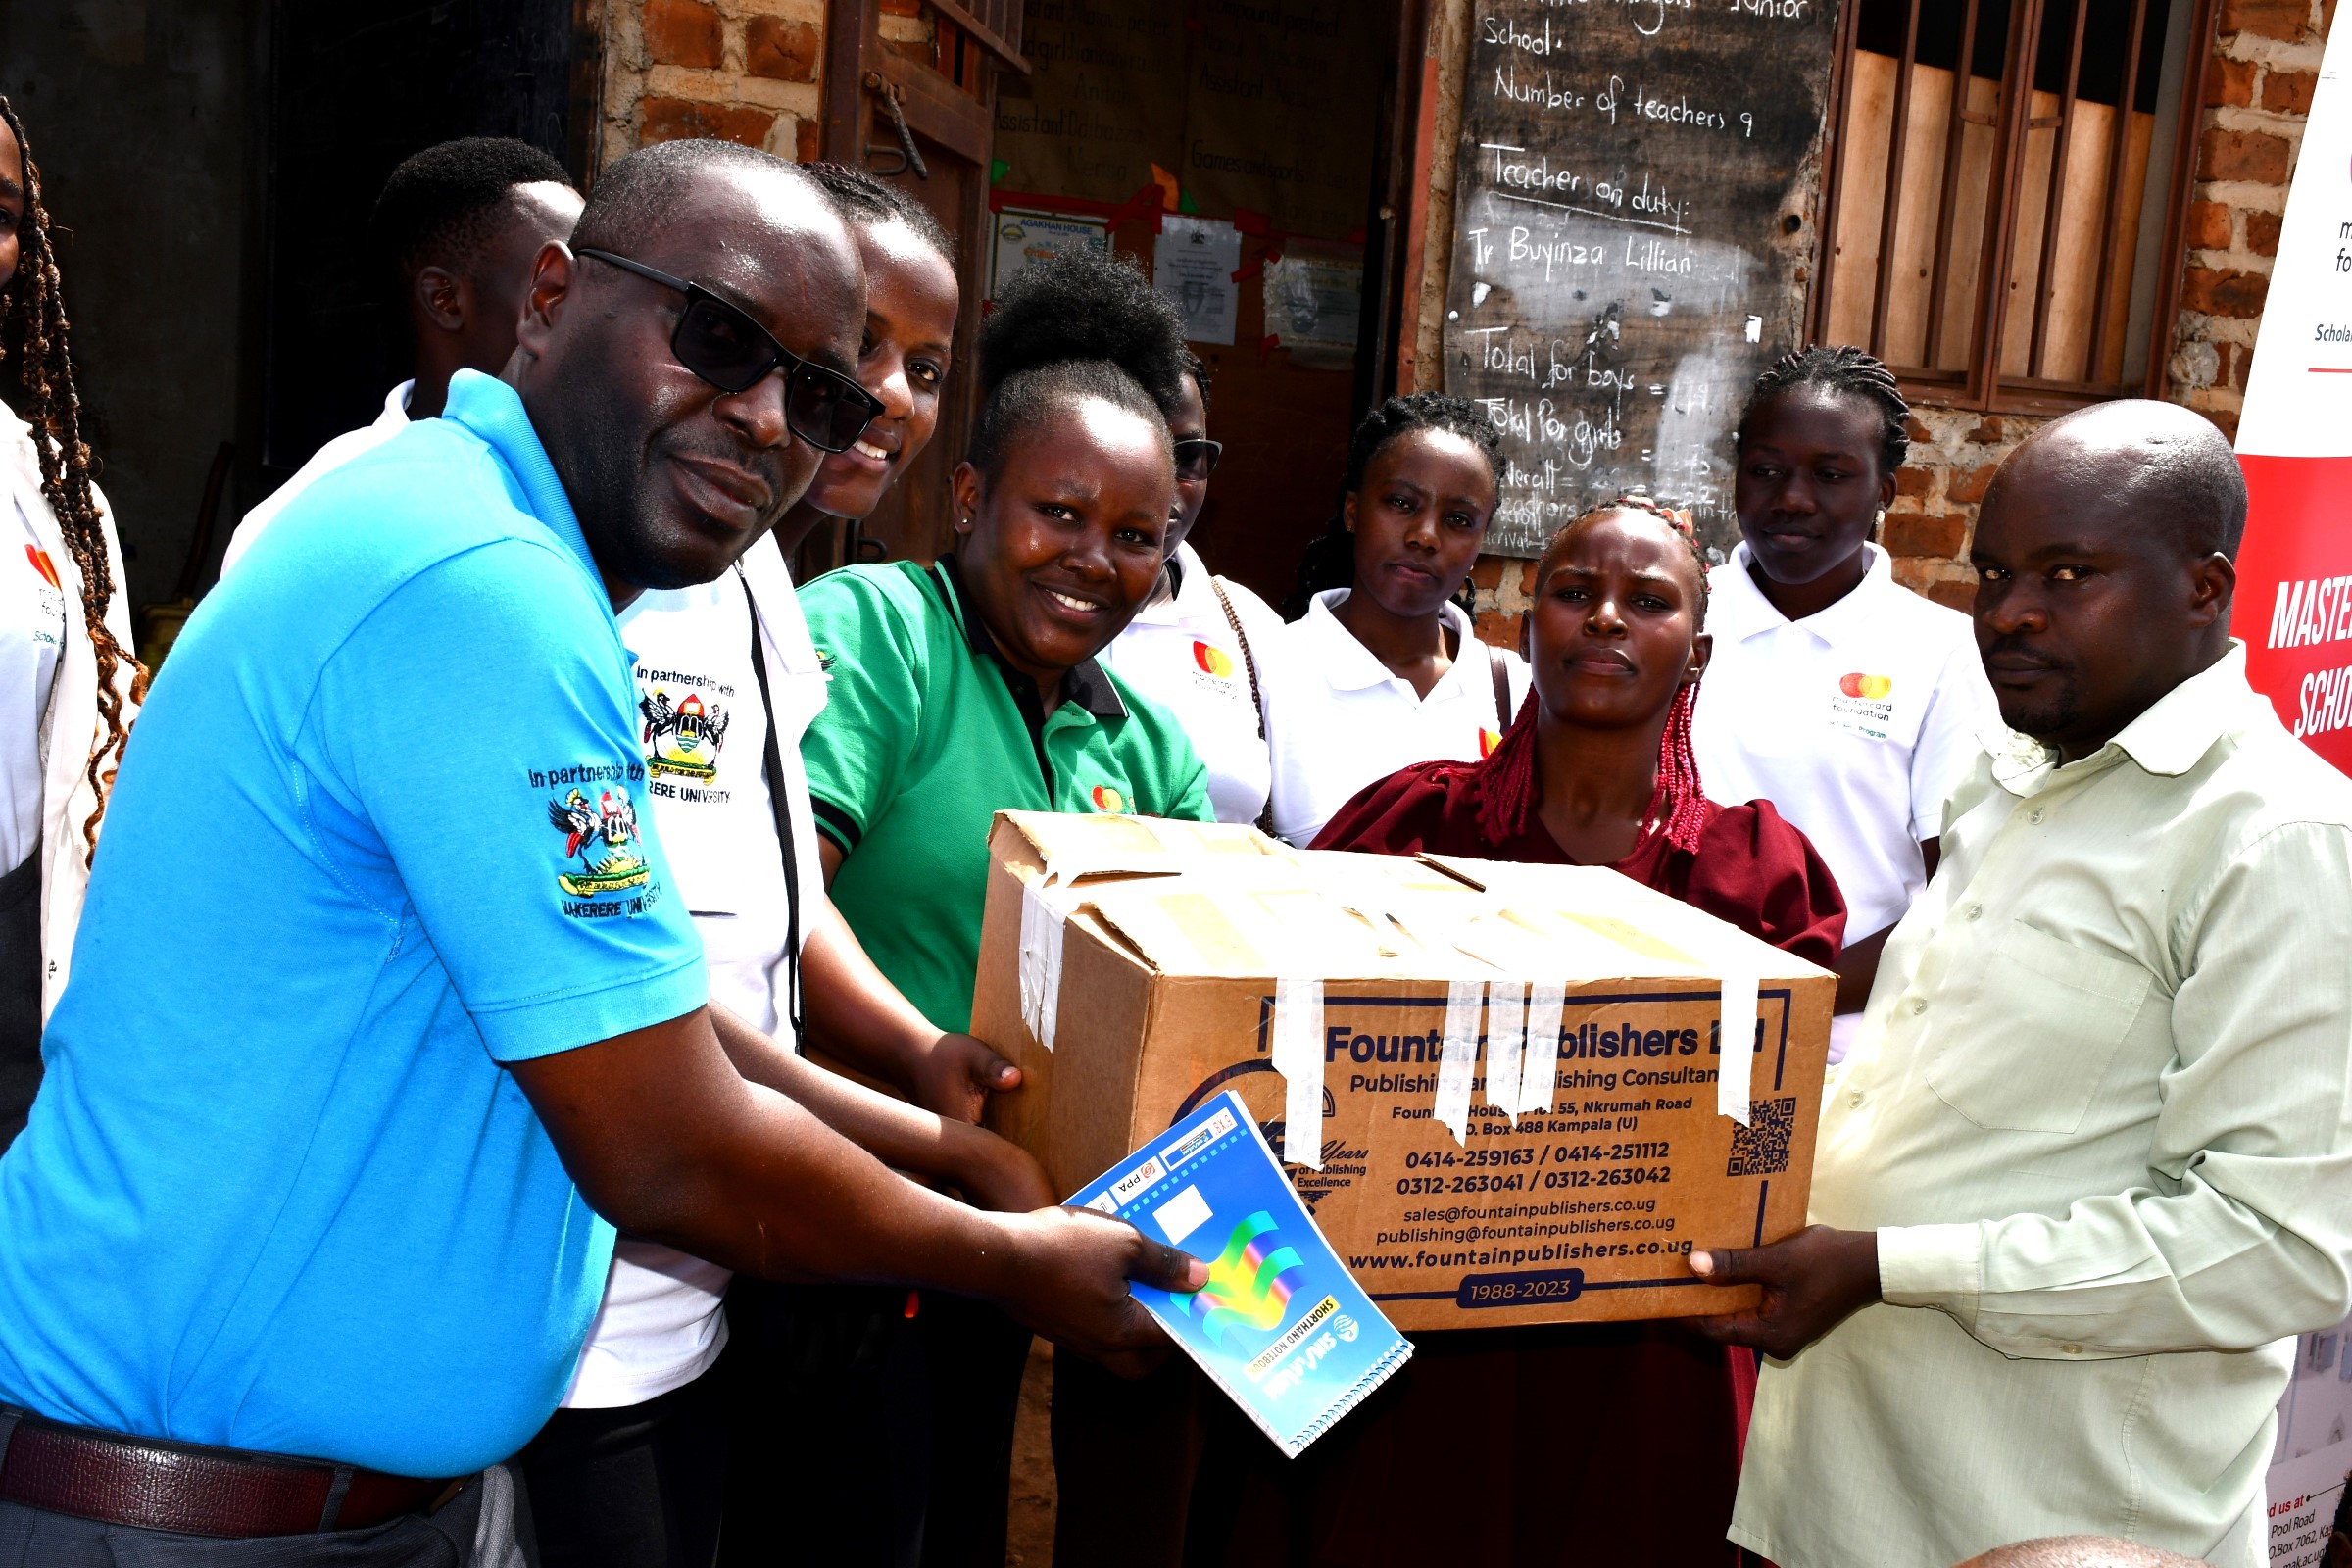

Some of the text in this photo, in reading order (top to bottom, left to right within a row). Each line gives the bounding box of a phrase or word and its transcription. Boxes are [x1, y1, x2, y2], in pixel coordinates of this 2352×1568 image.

[1494, 65, 1585, 110] Number
[1596, 75, 1624, 125] of
[1634, 85, 1725, 130] teachers
[1192, 139, 1241, 172] Games
[1480, 143, 1581, 192] Teacher
[1596, 183, 1622, 209] on
[1020, 219, 1063, 231] AGAKHAN
[1063, 223, 1093, 235] HOUSE
[1509, 227, 1604, 282] Buyinza
[1626, 236, 1691, 274] Lillian
[2315, 323, 2352, 343] Schola
[1464, 326, 1536, 380] Total
[1542, 339, 1577, 389] for
[1588, 351, 1635, 421] boys
[1474, 397, 1531, 443] Total
[2267, 574, 2352, 649] MASTE
[637, 665, 648, 679] In
[2294, 664, 2352, 739] SCHO
[528, 768, 546, 788] In
[1622, 1065, 1719, 1087] Consultan
[1558, 1102, 1579, 1116] 55,
[1583, 1099, 1651, 1114] Nkrumah
[1655, 1096, 1693, 1110] Road
[1482, 1123, 1512, 1136] Box
[1515, 1120, 1544, 1134] 488
[1547, 1117, 1612, 1134] Kampala
[1616, 1116, 1639, 1132] (U)
[1319, 1139, 1369, 1164] Years
[1405, 1148, 1535, 1169] 0414-259163
[1554, 1142, 1670, 1163] 0414-251112
[1117, 1173, 1142, 1194] PPA
[1297, 1177, 1351, 1188] Excellence
[1396, 1174, 1524, 1195] 0312-263041
[1544, 1166, 1671, 1189] 0312-263042
[1403, 1198, 1656, 1223] sales@fountainpublishers.co.ug
[1376, 1216, 1676, 1246] publishing@fountainpublishers.co.ug
[1349, 1238, 1694, 1270] www.fountainpublishers.co.ug
[1470, 1279, 1571, 1301] 1988-2023
[1289, 1299, 1334, 1345] SHORTHAND
[2278, 1500, 2291, 1515] us
[2294, 1494, 2304, 1508] at
[2271, 1508, 2316, 1539] Pool Road
